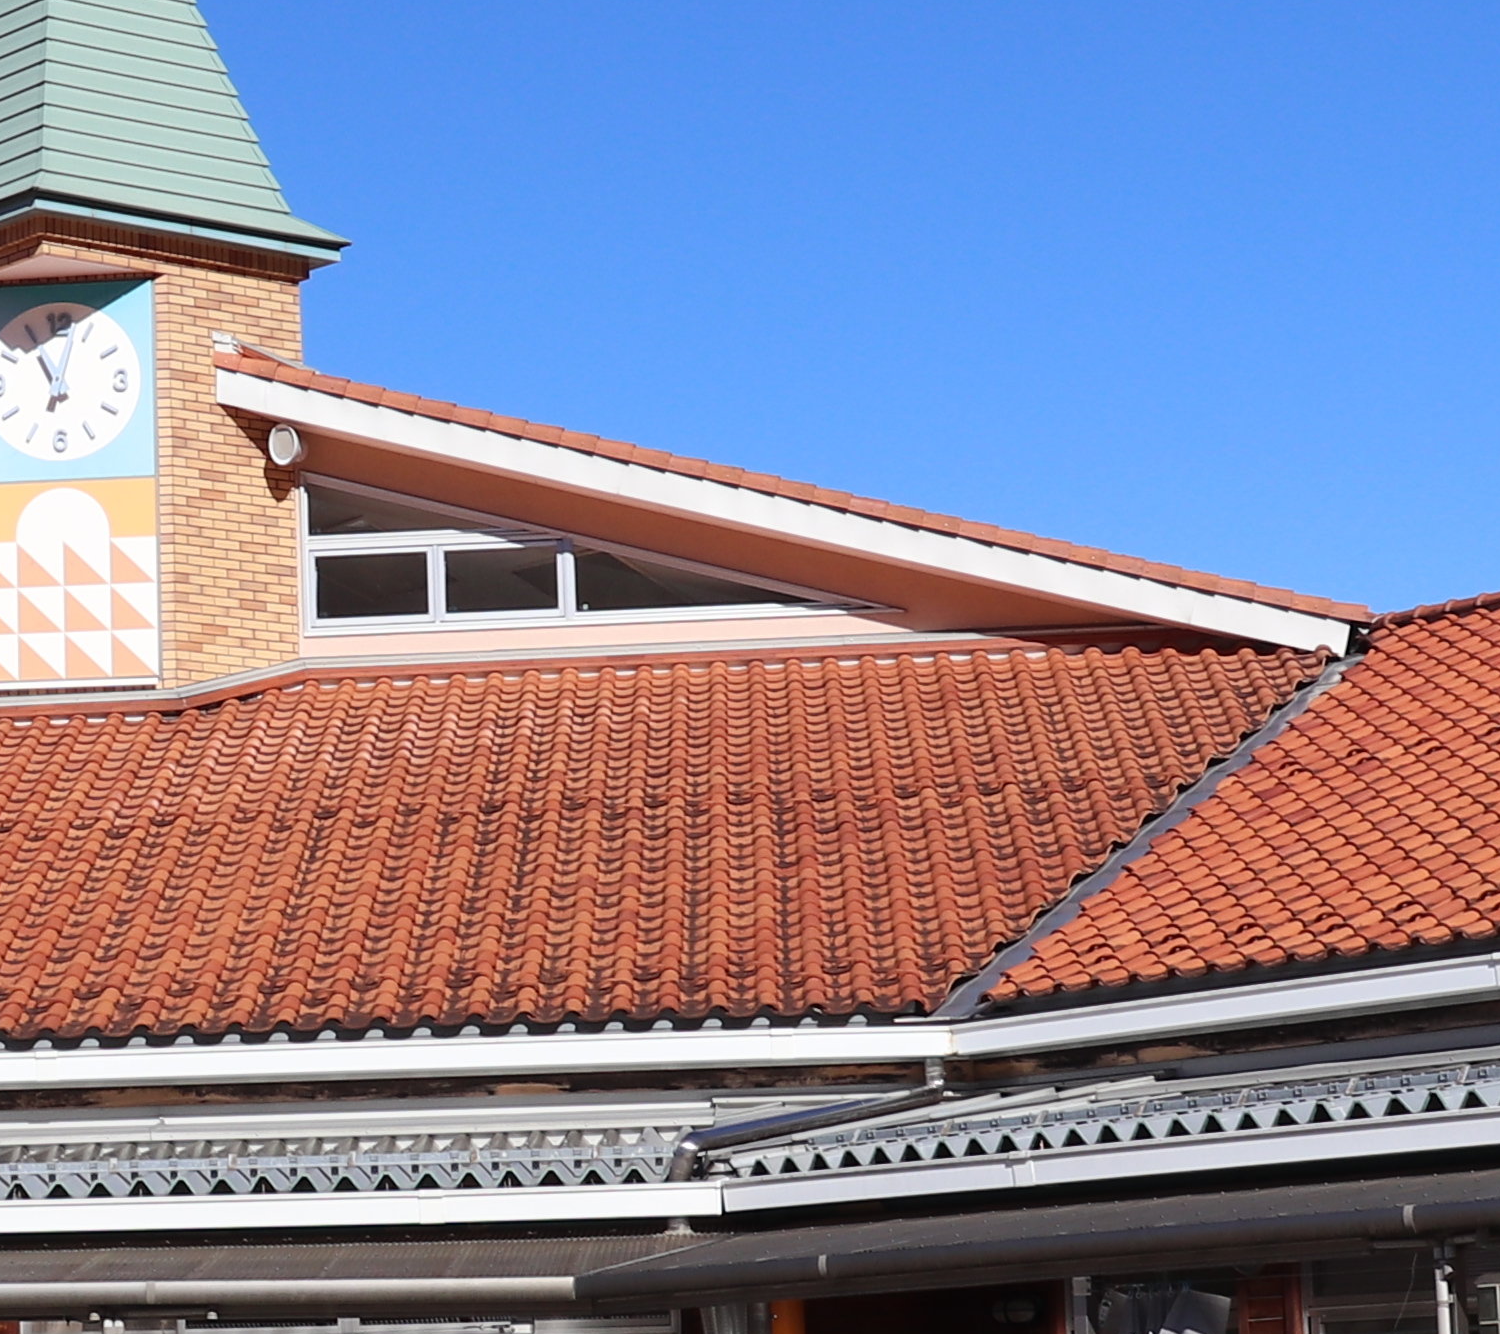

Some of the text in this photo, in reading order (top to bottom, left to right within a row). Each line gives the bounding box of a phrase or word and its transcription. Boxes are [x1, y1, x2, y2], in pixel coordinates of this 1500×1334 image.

[46, 312, 73, 337] 12
[112, 368, 128, 393] 3
[52, 429, 68, 453] 6
